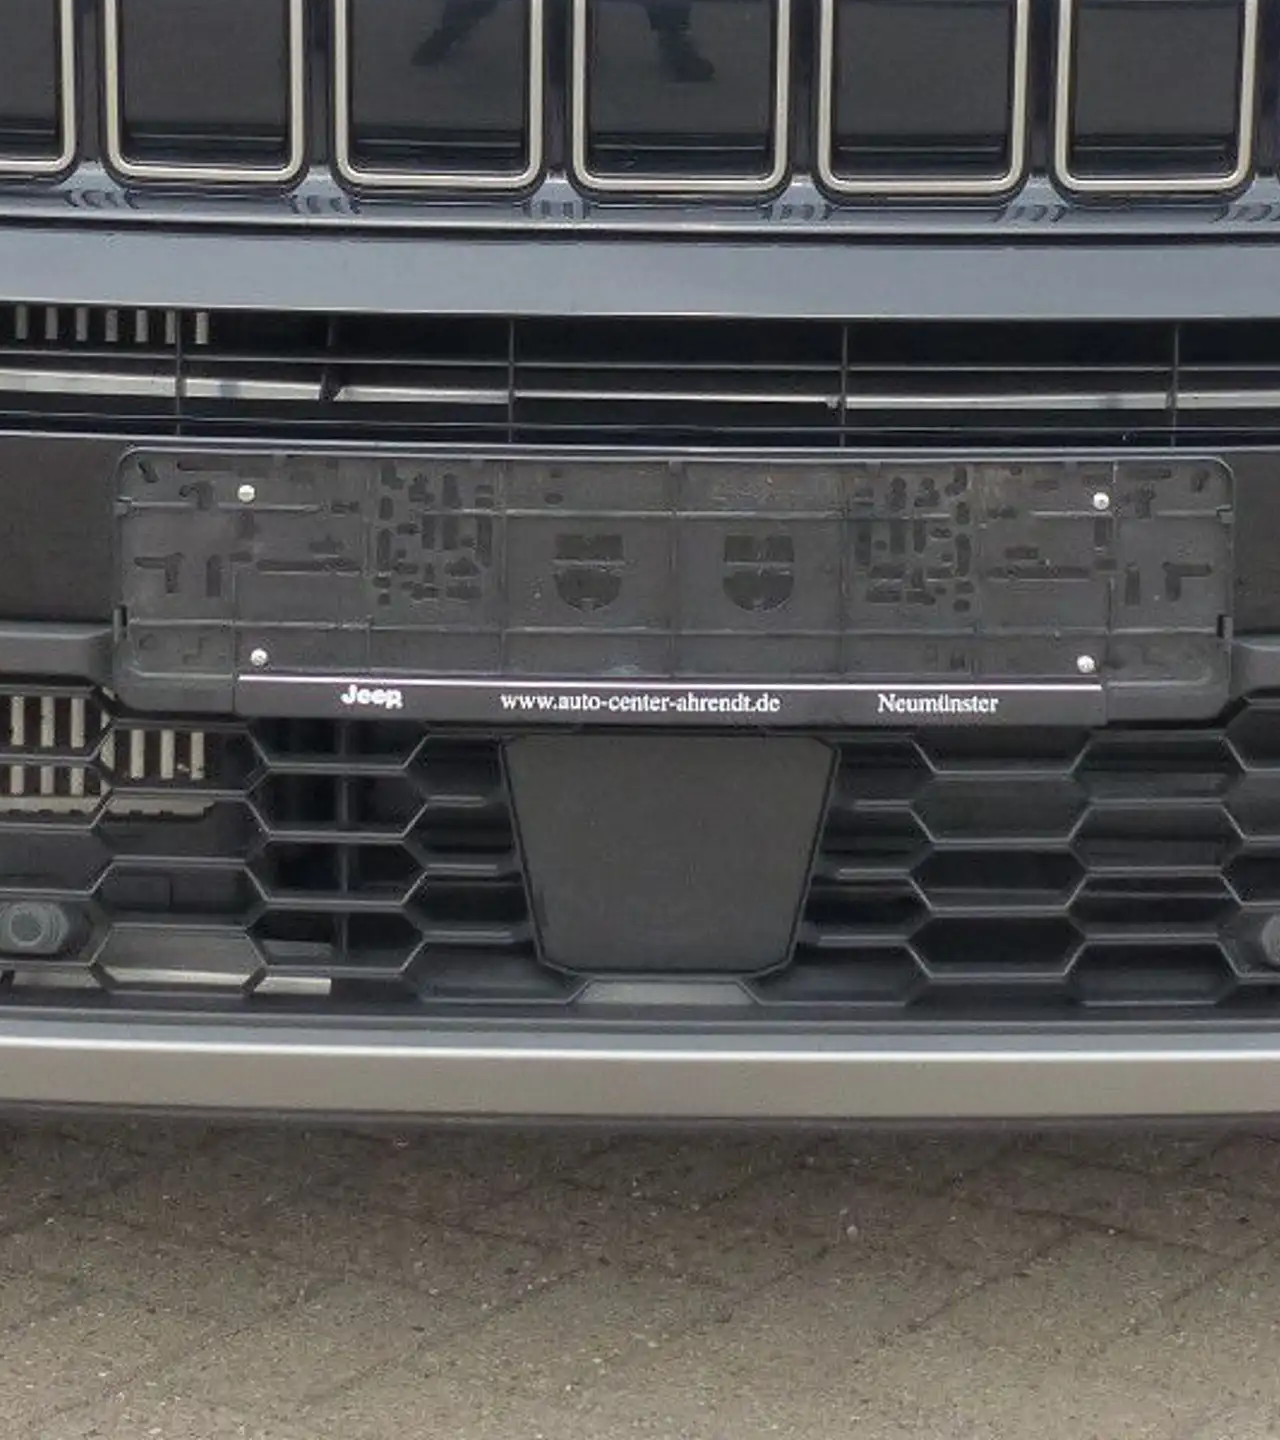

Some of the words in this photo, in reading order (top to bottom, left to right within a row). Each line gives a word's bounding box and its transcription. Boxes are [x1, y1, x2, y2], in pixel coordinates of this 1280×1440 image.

[340, 684, 404, 710] Jeep
[499, 691, 782, 713] www.auto-center-ahrendt.de
[876, 692, 1000, 713] Neumünster
